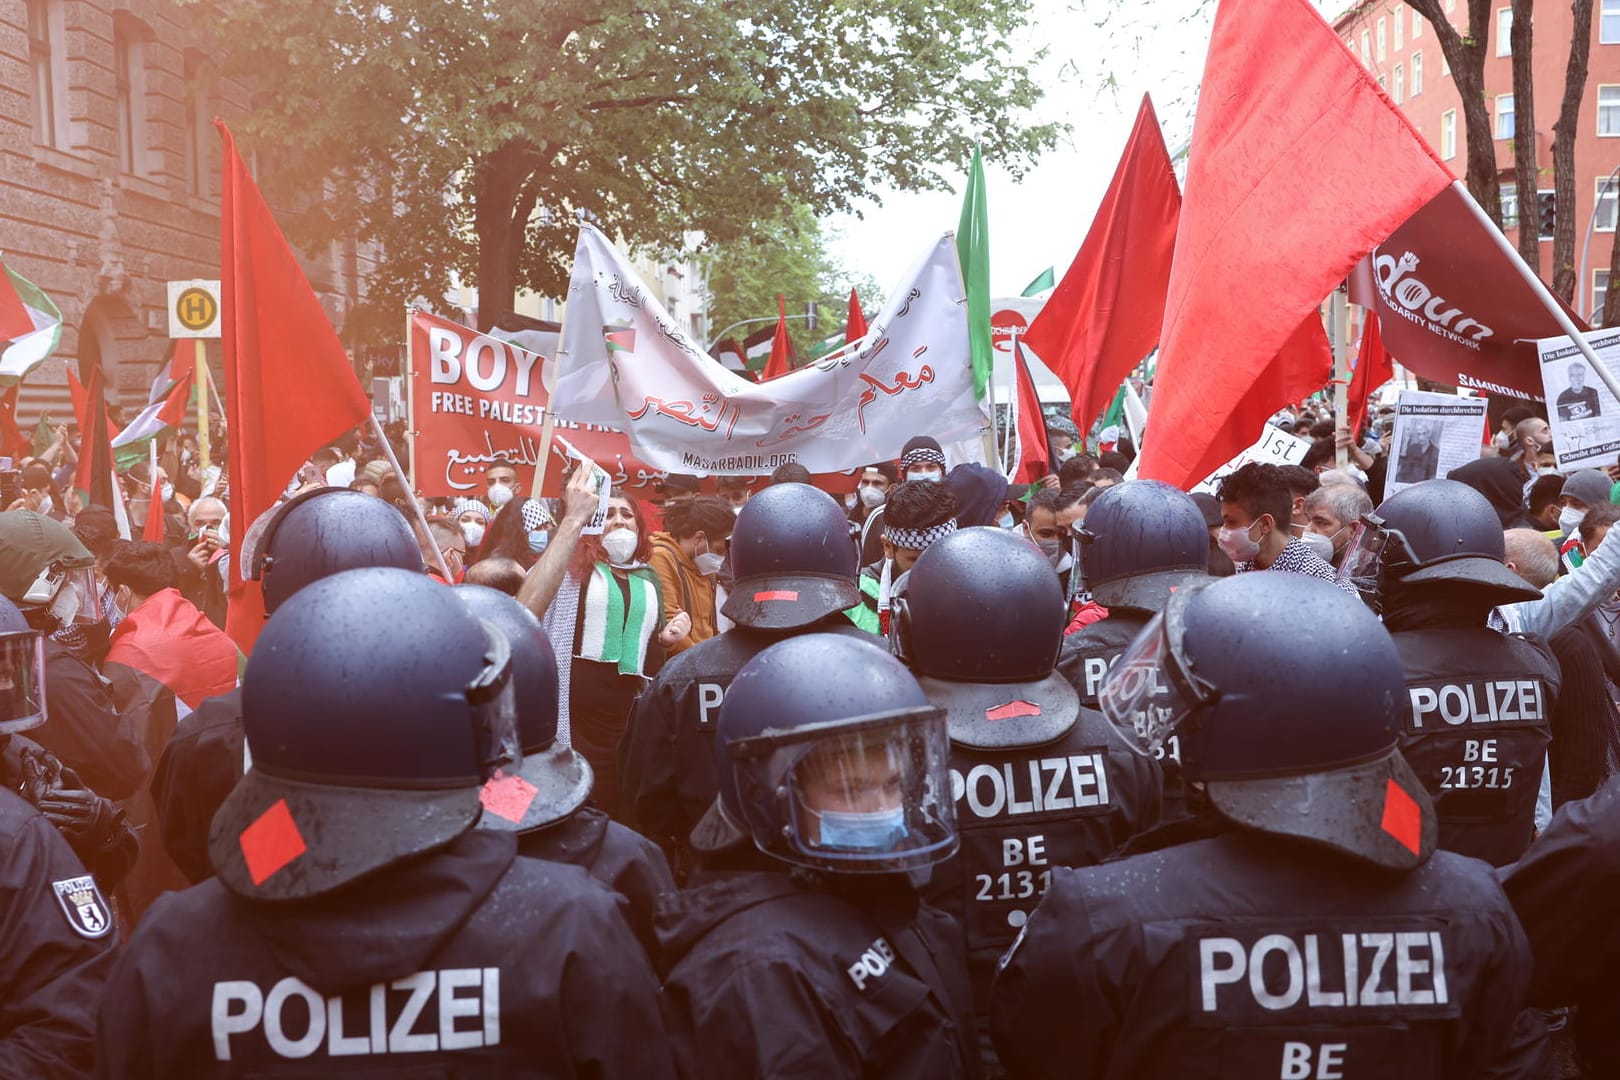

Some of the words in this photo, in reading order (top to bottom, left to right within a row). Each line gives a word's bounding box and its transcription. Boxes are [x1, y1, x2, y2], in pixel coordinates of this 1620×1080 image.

[1428, 322, 1480, 351] NETWORK
[429, 327, 552, 396] BOY
[431, 391, 474, 416] FREE
[683, 452, 797, 471] MASARBADIL.ORG
[1409, 680, 1543, 728] POLIZEI
[1464, 740, 1498, 762] BE
[1440, 766, 1515, 790] 21315
[1002, 835, 1048, 867] BE
[975, 869, 1052, 901] 2131
[1199, 932, 1449, 1012] POLIZEI
[211, 967, 500, 1061] POLIZEI
[1280, 1041, 1347, 1080] BE
